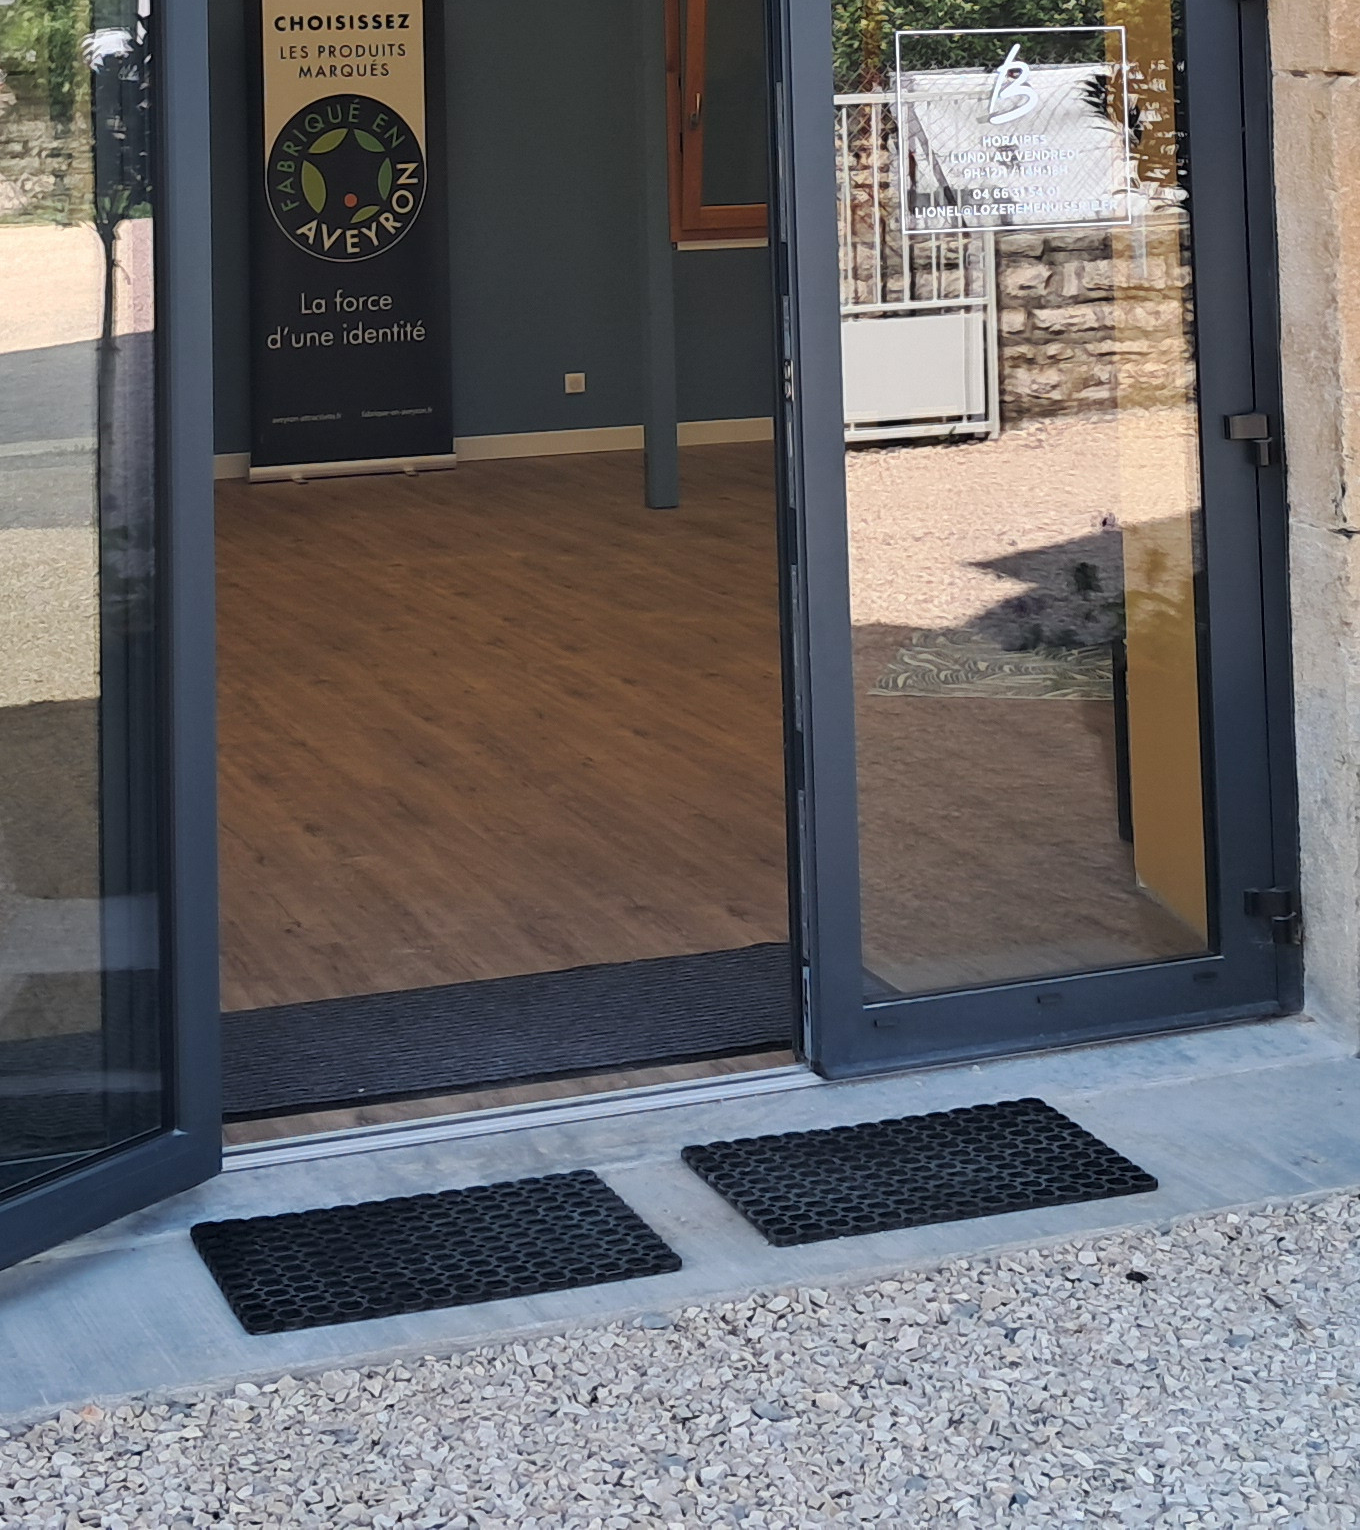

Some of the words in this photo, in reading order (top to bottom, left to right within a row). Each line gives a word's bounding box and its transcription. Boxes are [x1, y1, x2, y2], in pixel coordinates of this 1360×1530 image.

[274, 13, 411, 32] CHOISISSEZ
[279, 45, 310, 60] LES
[317, 43, 407, 58] PRODUITS
[298, 58, 390, 79] MARQUÉS
[276, 98, 362, 213] FABRIQUÉ
[371, 112, 406, 150] EN
[972, 188, 989, 200] 04
[993, 187, 1009, 199] 66
[295, 161, 420, 254] AVEYRON
[299, 292, 326, 315] La
[334, 289, 393, 313] force
[267, 326, 334, 350] d'une
[342, 320, 427, 346] identité
